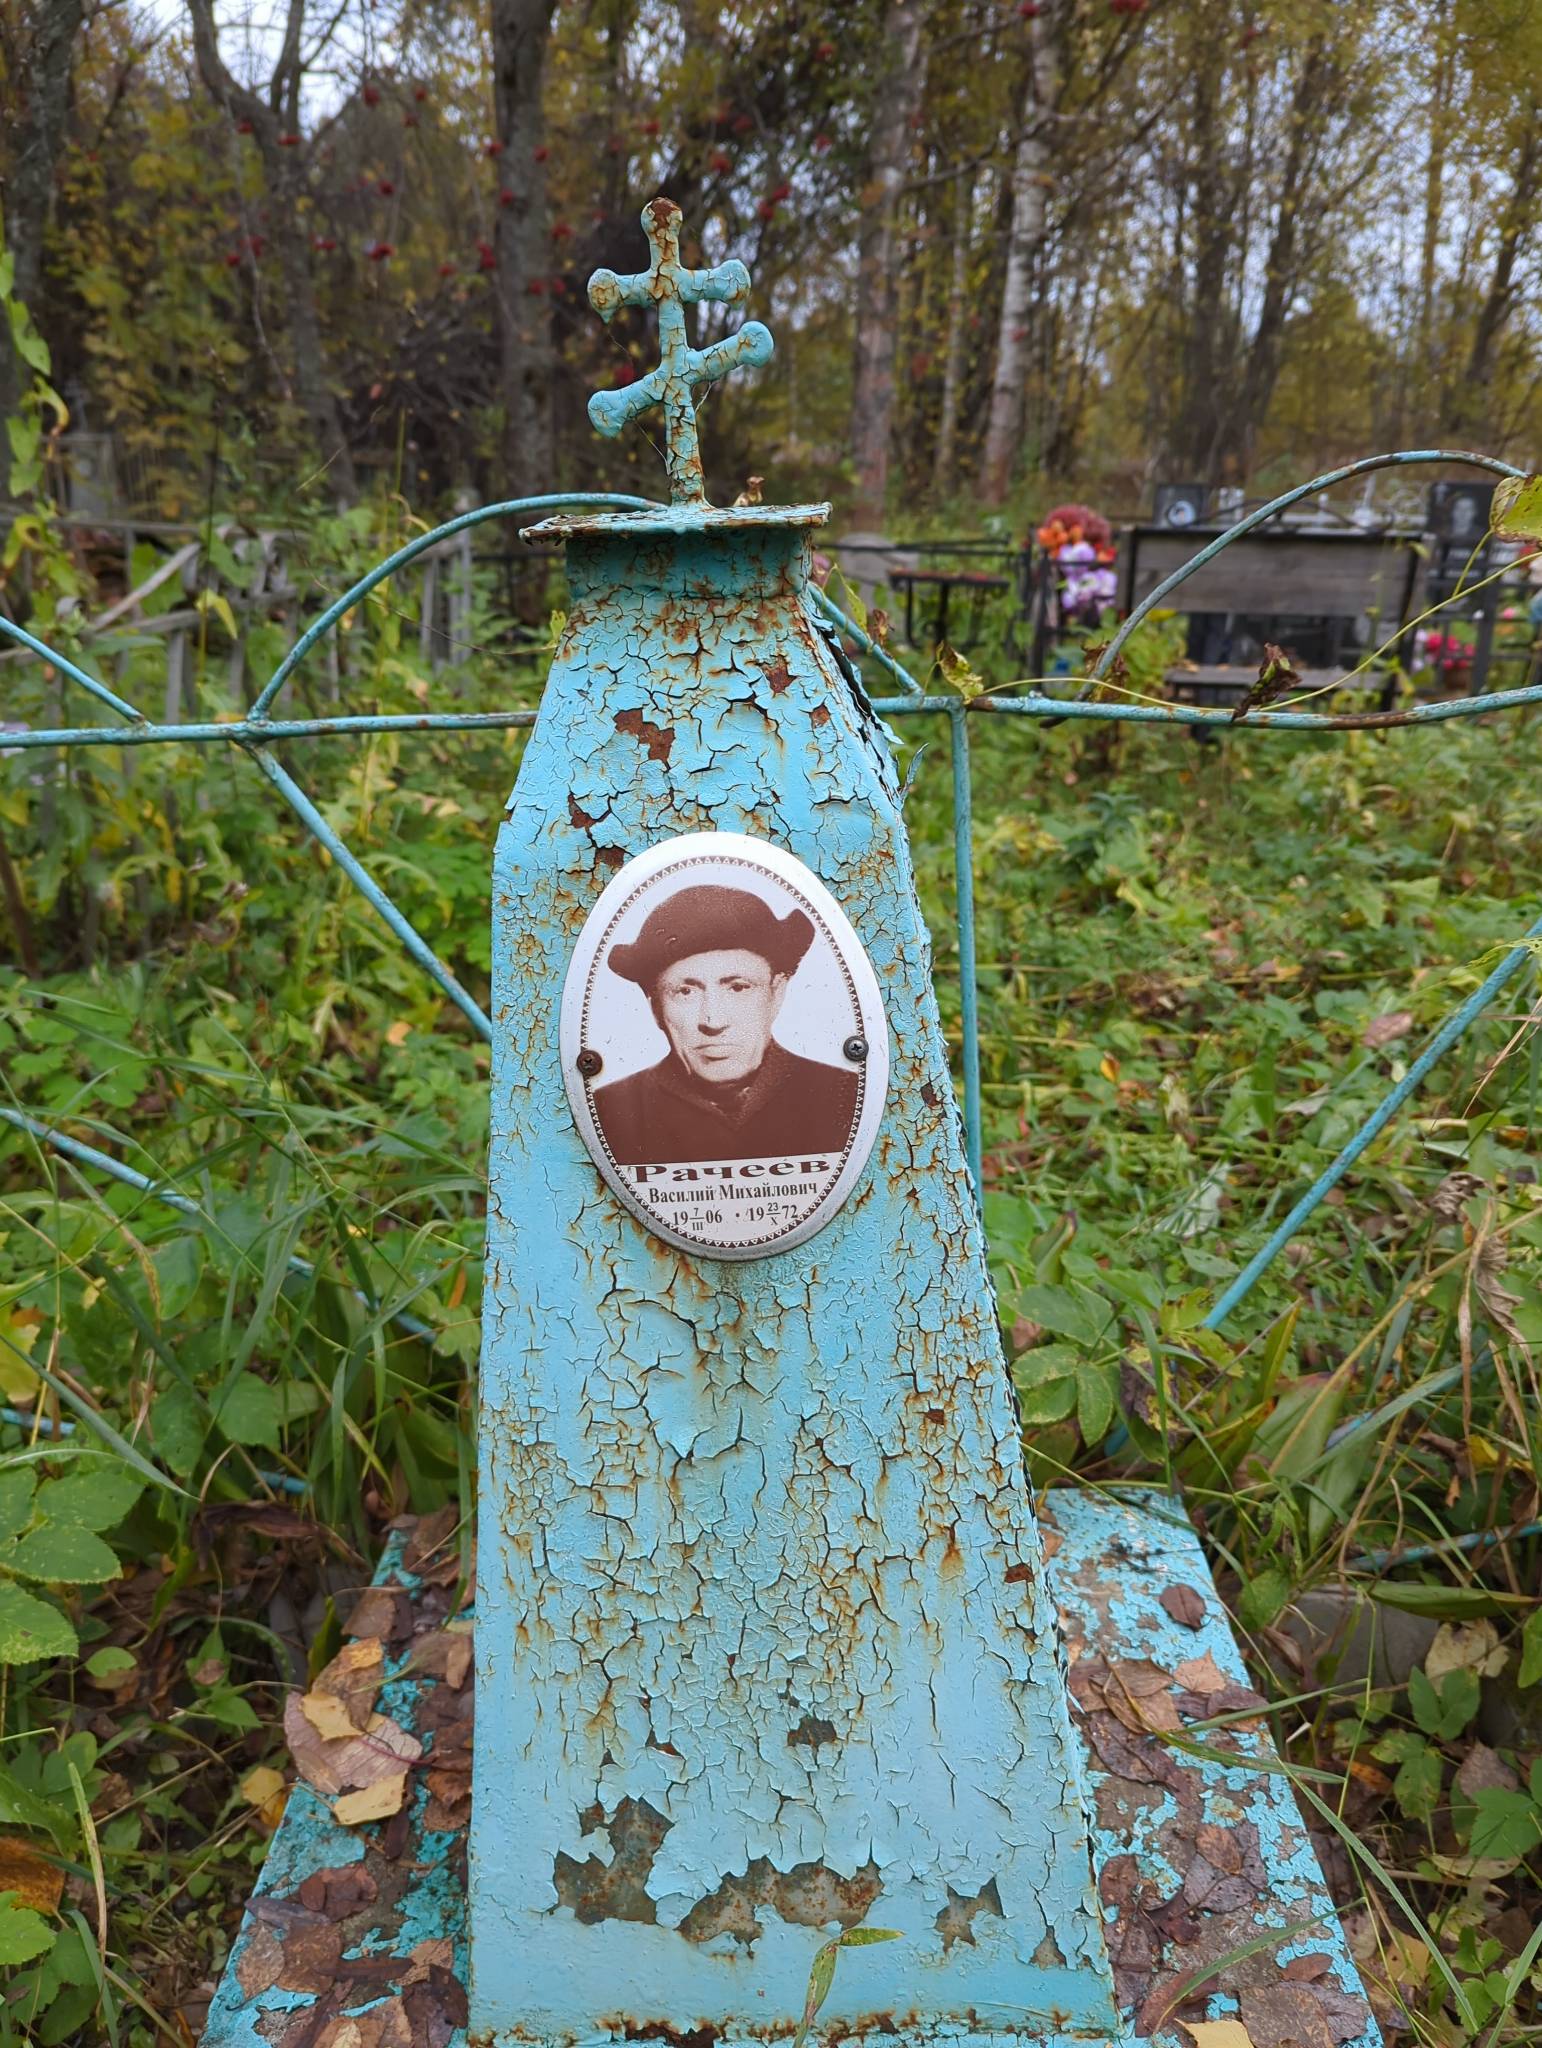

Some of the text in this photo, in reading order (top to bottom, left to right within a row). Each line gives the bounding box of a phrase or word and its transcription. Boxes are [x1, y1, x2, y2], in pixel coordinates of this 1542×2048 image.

[628, 1160, 831, 1183] Рачеев
[649, 1182, 818, 1203] Василий Михайлович
